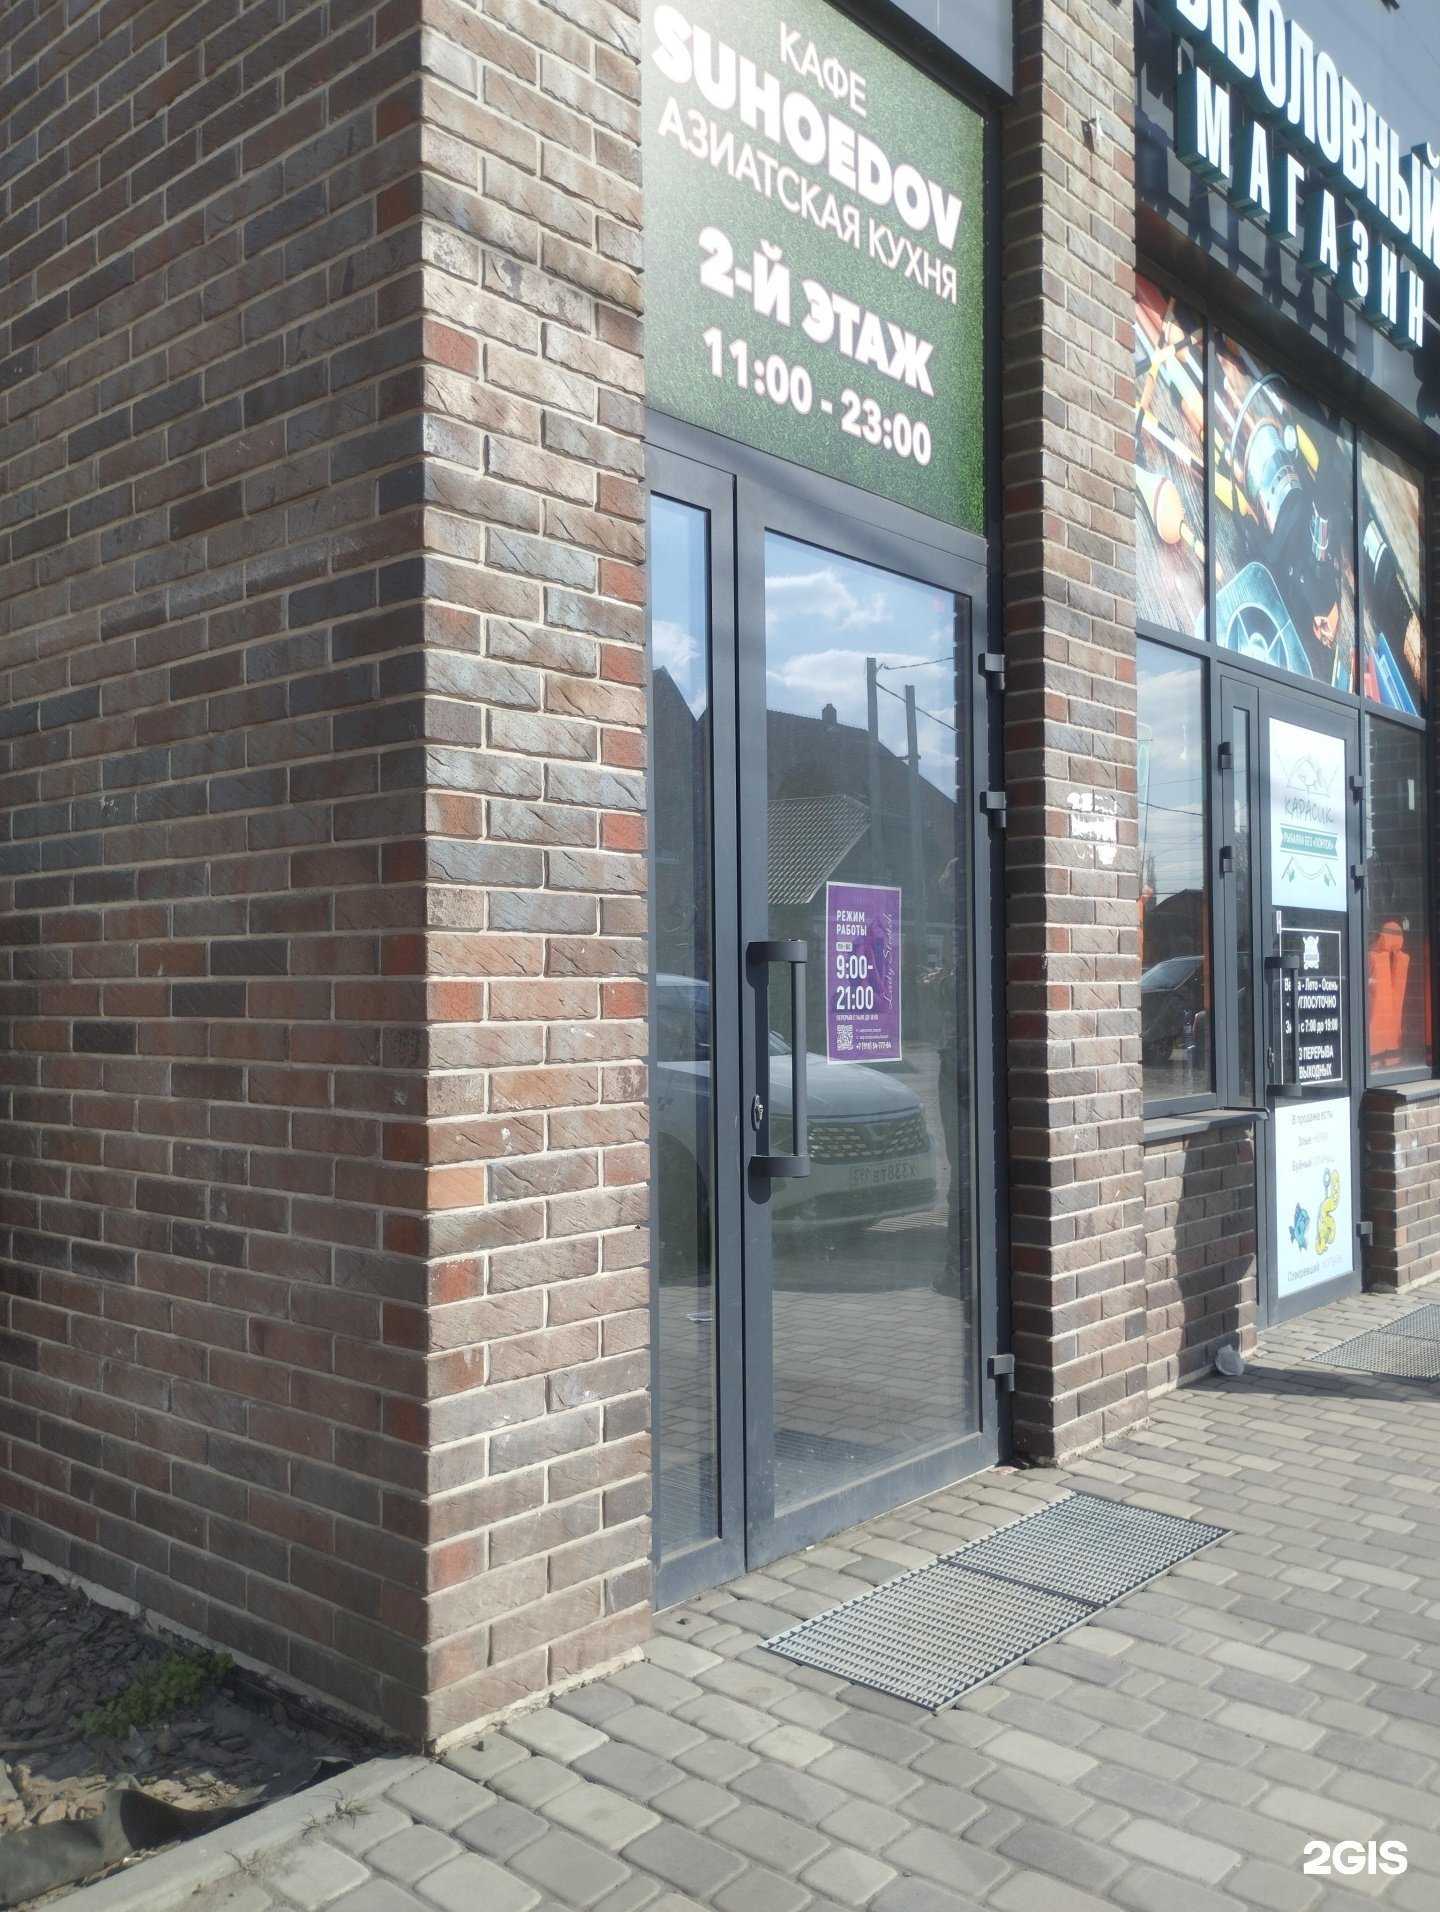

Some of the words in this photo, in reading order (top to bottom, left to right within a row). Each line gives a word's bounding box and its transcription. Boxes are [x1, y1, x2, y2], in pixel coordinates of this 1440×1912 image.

[780, 22, 867, 117] КАФЕ
[652, 5, 963, 250] SUHOEDOV
[658, 98, 860, 248] АЗИАТСКАЯ
[869, 219, 957, 304] КУХНЯ
[1196, 67, 1424, 348] МАГАЗИН
[699, 226, 791, 327] 2-Й
[801, 279, 934, 395] ЭТАЖ
[703, 327, 812, 415] 11:00
[840, 390, 931, 465] 23:00
[836, 910, 865, 923] РЕЖИМ
[836, 924, 867, 936] РАБОТЫ
[836, 955, 873, 979] 9:00-
[836, 986, 874, 1010] 21:00
[1303, 1045, 1334, 1060] ПЕРЕРЫВА
